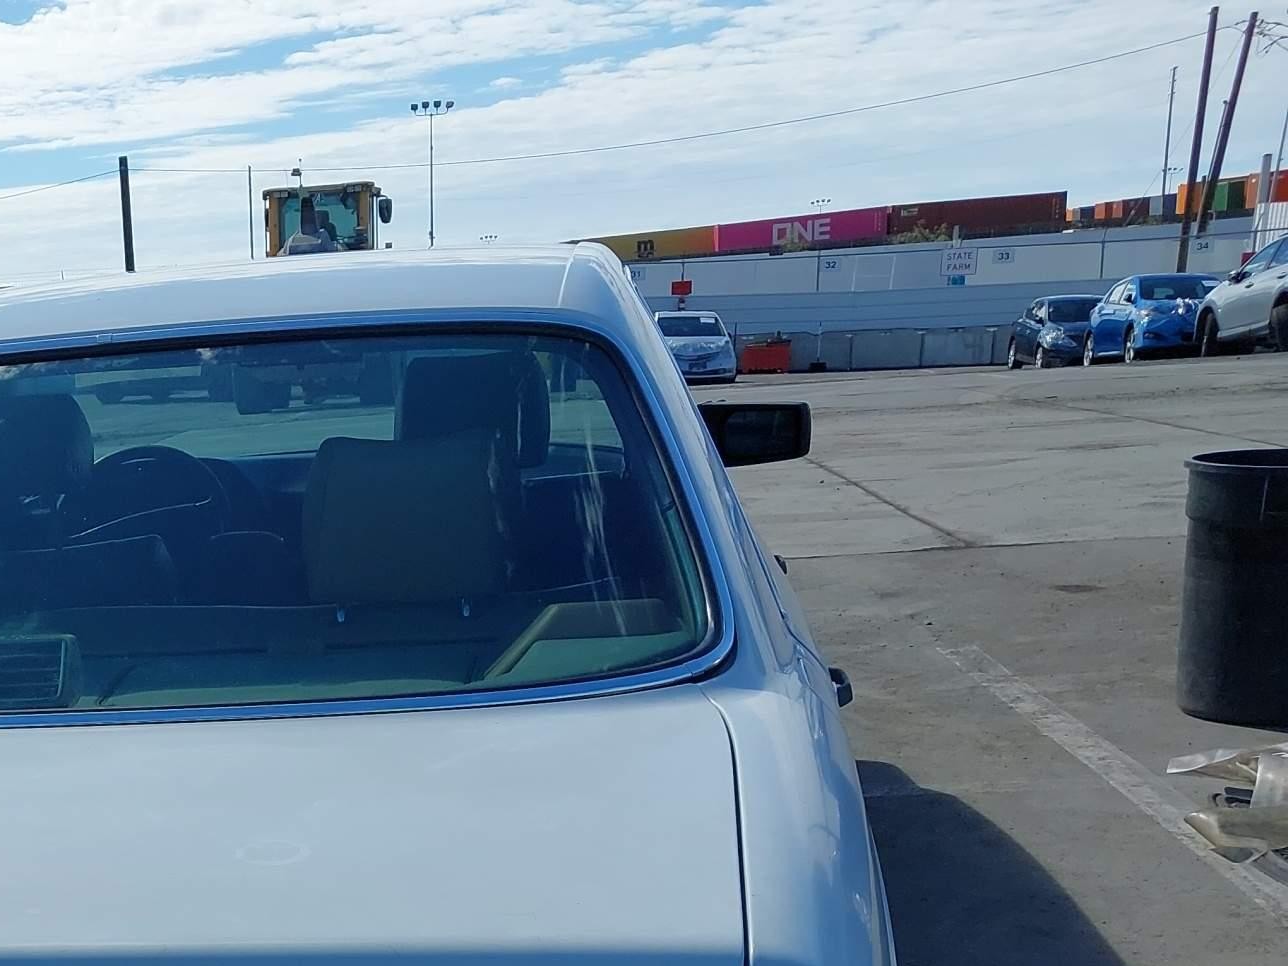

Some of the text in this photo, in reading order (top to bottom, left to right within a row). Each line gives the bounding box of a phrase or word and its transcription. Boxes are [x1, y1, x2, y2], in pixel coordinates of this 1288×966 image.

[772, 218, 831, 245] ONE
[1196, 242, 1209, 251] 34
[946, 252, 973, 261] STATE
[998, 252, 1010, 261] 33
[825, 260, 837, 269] 32
[946, 264, 971, 272] FARM
